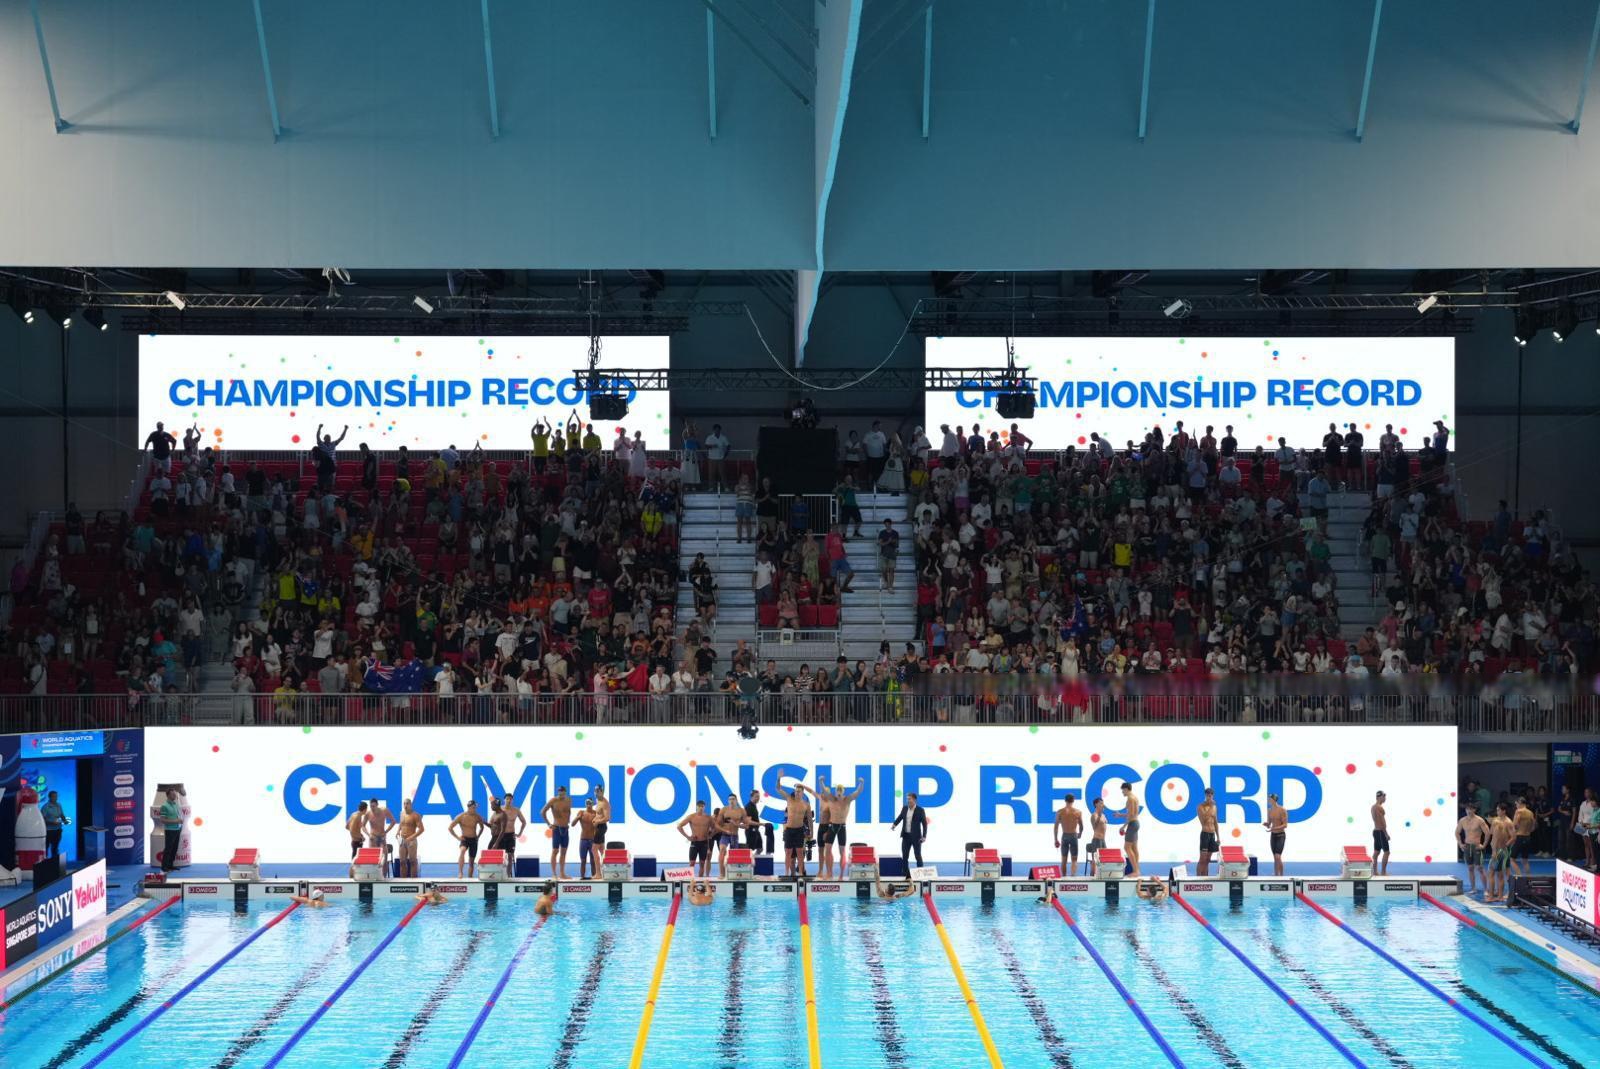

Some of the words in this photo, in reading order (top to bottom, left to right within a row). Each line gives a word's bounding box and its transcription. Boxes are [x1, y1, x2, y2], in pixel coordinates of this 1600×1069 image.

[169, 379, 472, 407] CHAMPIONSHIP
[1267, 379, 1422, 406] RECORD
[283, 763, 954, 825] CHAMPIONSHIP
[980, 763, 1323, 825] RECORD
[75, 876, 104, 910] Yakult
[1562, 870, 1587, 893] SINGAPORE
[1563, 887, 1587, 909] AQUATICS
[38, 890, 72, 934] SONY
[6, 918, 19, 934] WORLD
[6, 929, 28, 949] SINGAPORE
